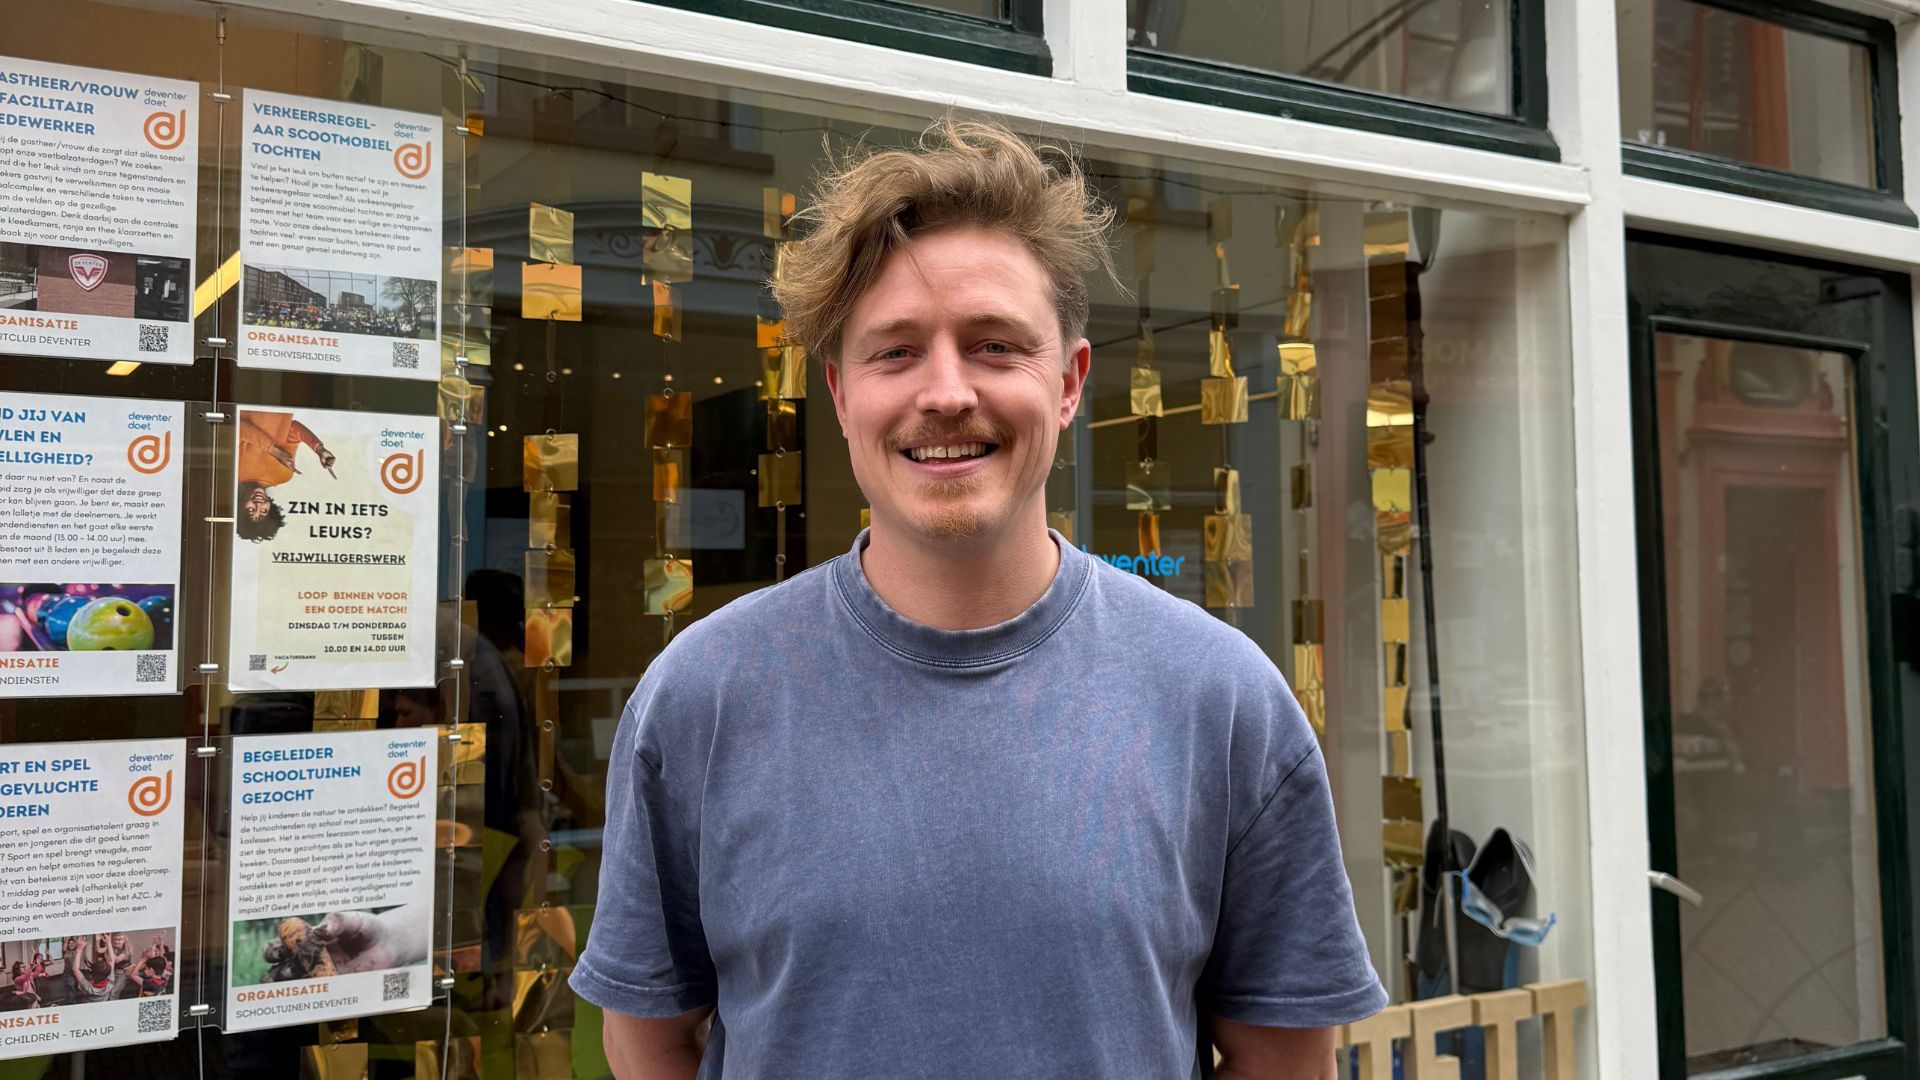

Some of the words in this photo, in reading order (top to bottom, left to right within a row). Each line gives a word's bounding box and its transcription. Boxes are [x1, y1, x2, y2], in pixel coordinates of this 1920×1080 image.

[0, 70, 139, 100] ASTHEER/VROUW
[143, 87, 187, 100] deventer
[0, 91, 94, 115] FACILITAIR
[143, 96, 167, 108] doet
[0, 112, 95, 135] EDEWERKER
[252, 102, 376, 130] VERKEERSREGEL-
[393, 120, 432, 133] deventer
[393, 129, 414, 139] doet
[252, 122, 284, 137] AAR
[287, 127, 392, 152] SCOOTMOBIEL
[251, 141, 321, 161] TOCHTEN
[0, 314, 78, 330] GANISATIE
[38, 335, 91, 347] DEVENTER
[246, 330, 338, 347] ORGANISATIE
[246, 347, 260, 356] DE
[260, 348, 342, 363] STOKVISRIJDERS
[17, 408, 46, 422] JIJ
[50, 409, 86, 423] VAN
[127, 411, 172, 422] deventer
[127, 420, 151, 430] doet
[40, 430, 61, 443] EN
[380, 427, 424, 439] deventer
[380, 437, 404, 448] doet
[0, 450, 93, 466] ELLIGHEID?
[287, 500, 320, 514] ZIN
[324, 502, 345, 515] IN
[350, 503, 388, 517] IETS
[309, 524, 372, 539] LEUKS?
[271, 551, 406, 566] VRIJWILLIGERSWERK
[1079, 544, 1186, 576] venter
[297, 590, 328, 600] LOOP
[332, 591, 374, 600] BINNEN
[376, 591, 408, 600] VOOR
[304, 604, 326, 614] EEN
[327, 605, 364, 614] GOEDE
[366, 605, 407, 614] MATCH!
[288, 621, 331, 629] DINSDAG
[351, 621, 407, 629] DONDERDAG
[370, 633, 404, 641] TUSSEN
[323, 645, 348, 653] 10.00
[349, 644, 361, 653] EN
[362, 644, 386, 652] 14.00
[0, 657, 59, 669] NISATIE
[0, 675, 60, 685] NDIENSTEN
[387, 740, 427, 750] deventer
[128, 752, 174, 763] deventer
[242, 746, 333, 763] BEGELEIDER
[387, 749, 408, 758] doet
[0, 761, 20, 774] RT
[24, 759, 46, 773] EN
[50, 758, 91, 772] SPEL
[128, 762, 152, 772] doet
[242, 765, 361, 784] SCHOOLTUINEN
[0, 779, 98, 796] GEVLUCHTE
[241, 788, 314, 804] GEZOCHT
[236, 982, 329, 1002] ORGANISATIE
[235, 1001, 311, 1019] SCHOOLTUINEN
[312, 995, 359, 1010] DEVENTER
[0, 1013, 59, 1029] NISATIE
[4, 1031, 60, 1046] CHILDREN
[69, 1027, 97, 1038] TEAM
[99, 1025, 115, 1035] UP
